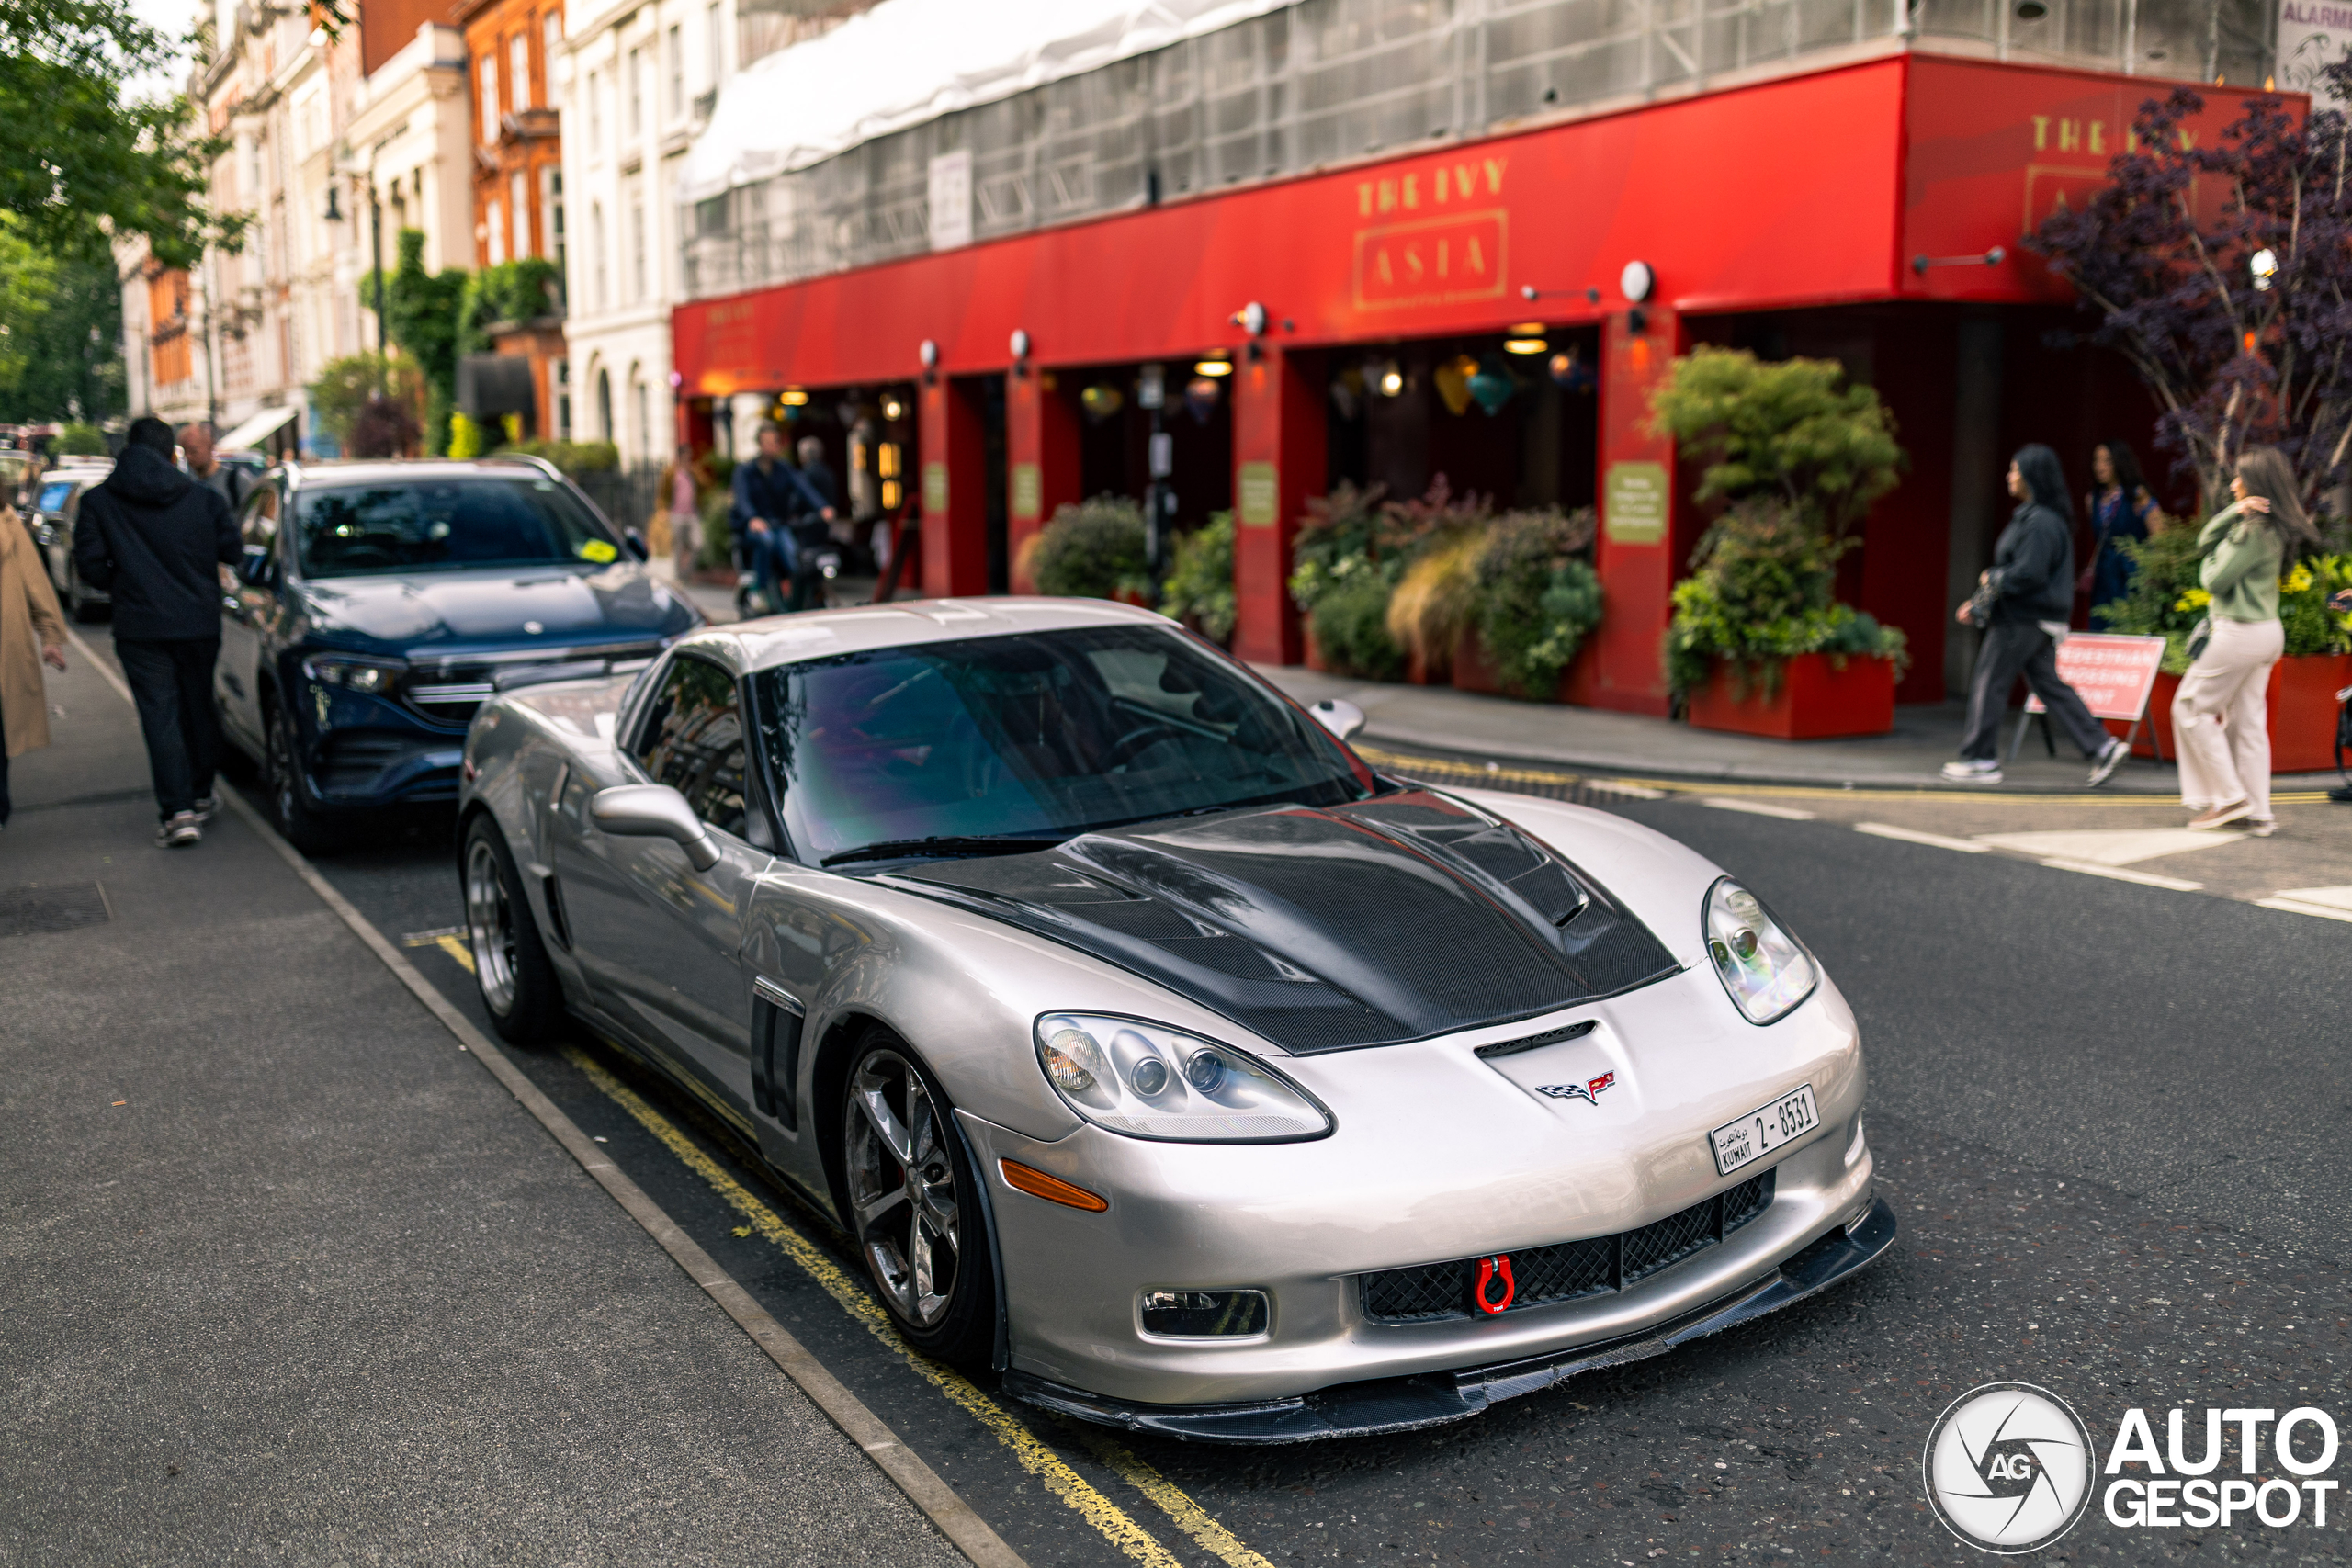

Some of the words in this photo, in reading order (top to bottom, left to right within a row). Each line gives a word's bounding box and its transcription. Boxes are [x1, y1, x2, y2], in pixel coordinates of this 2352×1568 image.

[2283, 2, 2352, 29] ALARM
[2031, 114, 2106, 155] THE
[2127, 125, 2199, 159] IY
[1356, 171, 1419, 218] THE
[1433, 156, 1508, 204] IVY
[1372, 235, 1486, 287] ASIA
[1755, 1116, 1769, 1150] 2
[1778, 1092, 1812, 1137] 8531
[1722, 1141, 1752, 1168] KUWAIT
